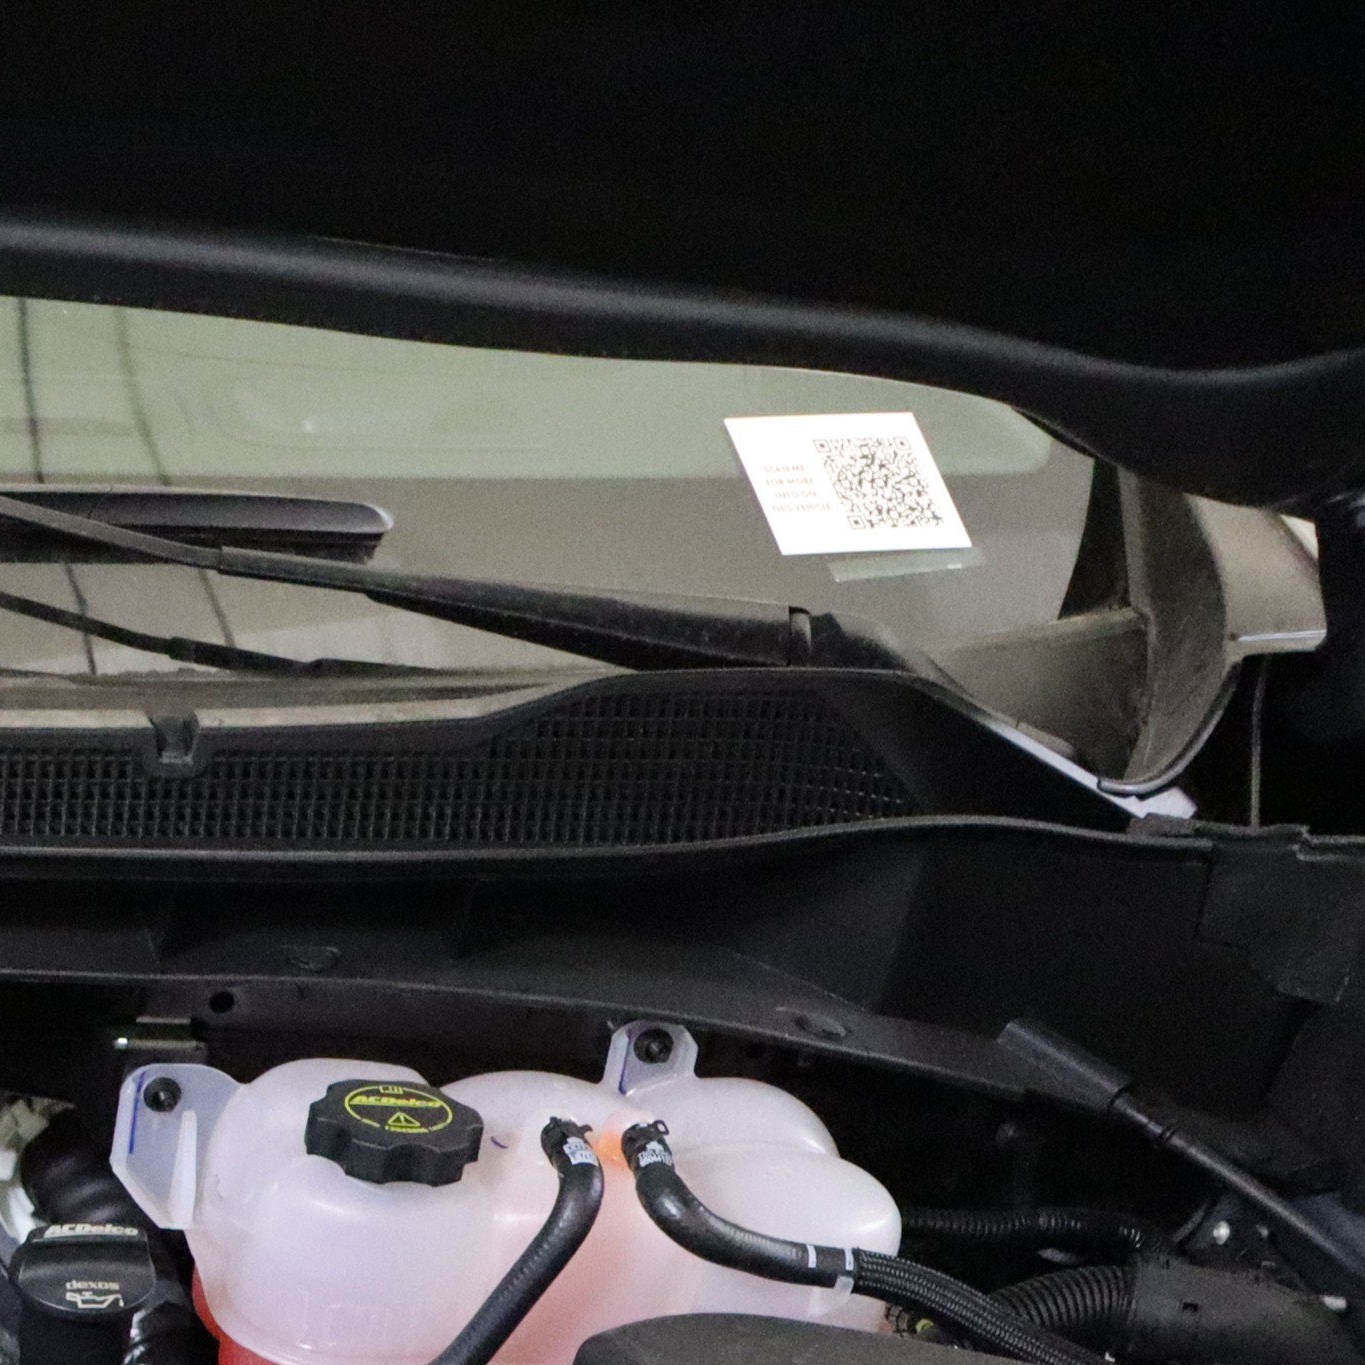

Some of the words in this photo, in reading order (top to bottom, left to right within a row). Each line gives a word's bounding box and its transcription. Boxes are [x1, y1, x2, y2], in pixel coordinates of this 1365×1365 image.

[349, 1094, 443, 1109] ACDelco
[43, 1222, 139, 1239] ACDelco
[65, 1279, 120, 1291] dexos
